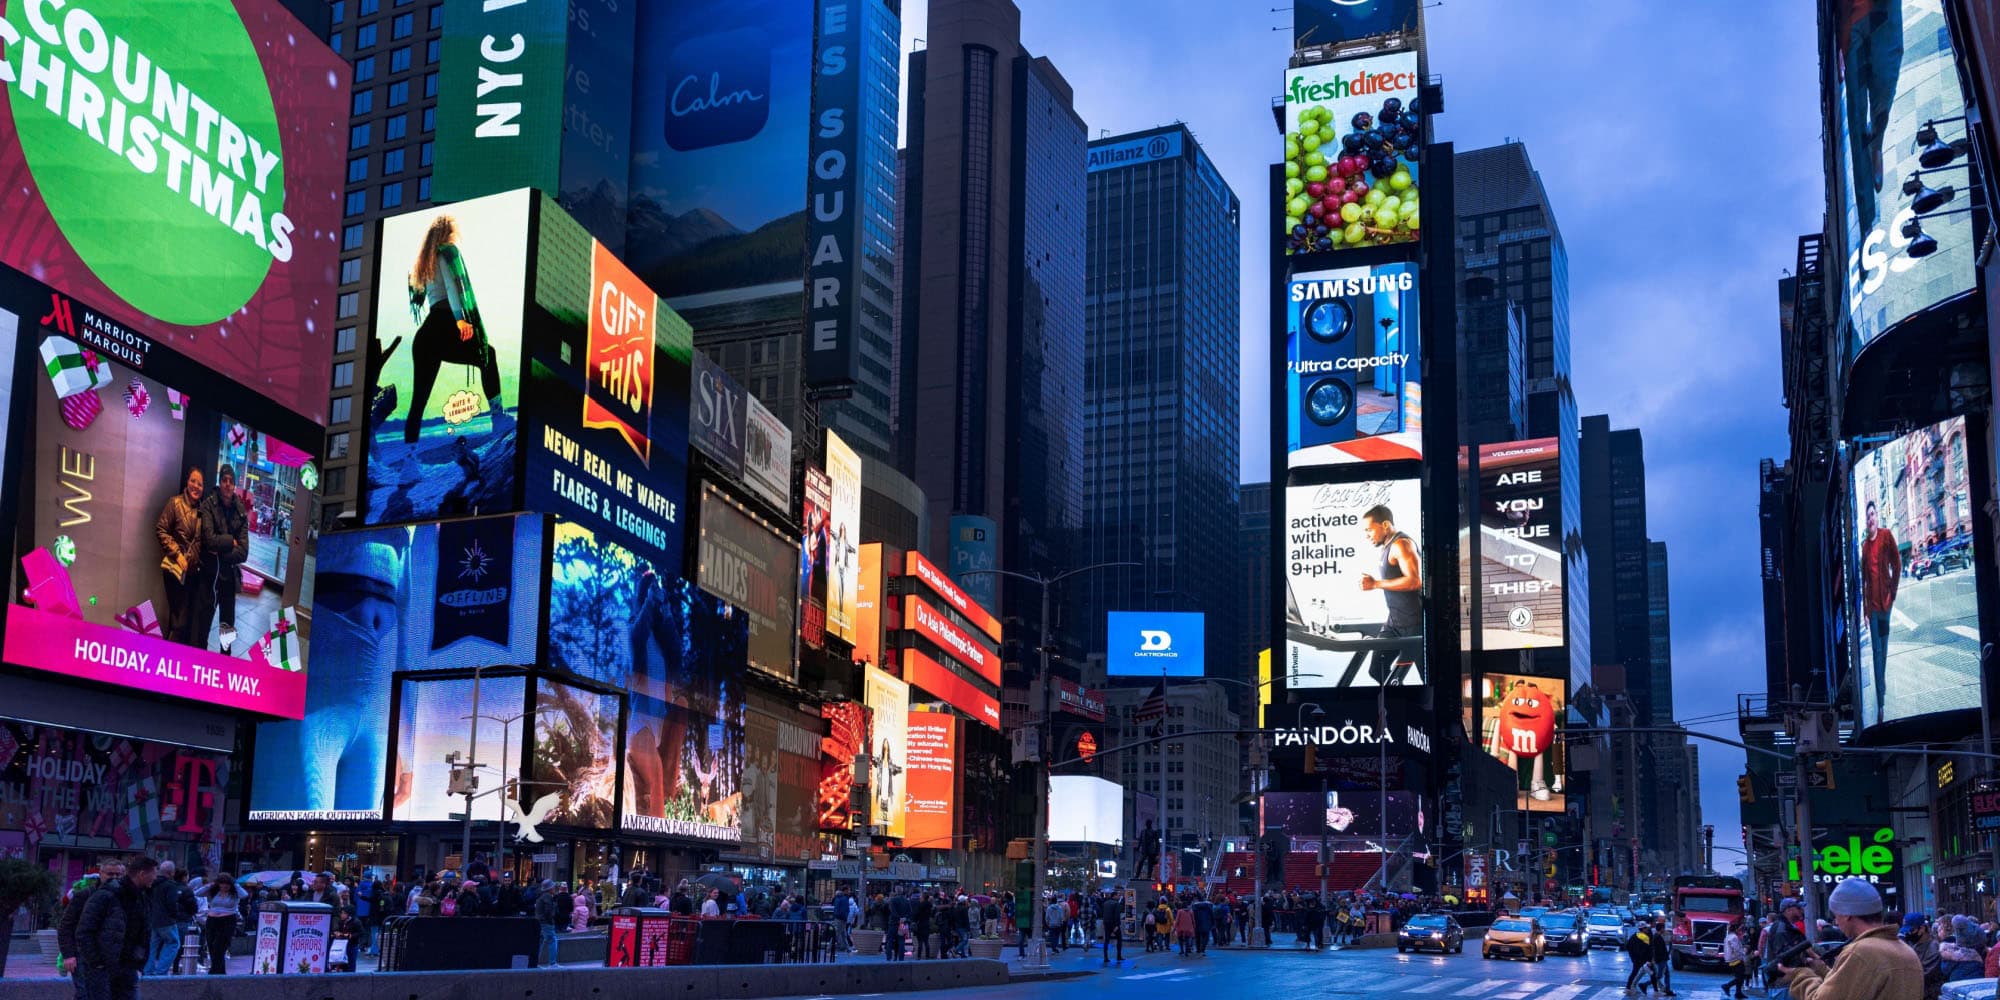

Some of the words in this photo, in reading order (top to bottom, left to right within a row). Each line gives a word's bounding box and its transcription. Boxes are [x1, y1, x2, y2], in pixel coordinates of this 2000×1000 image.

[23, 0, 281, 194] COUNTRY
[474, 32, 526, 139] NYC
[669, 71, 764, 118] Calm
[1290, 70, 1417, 105] freshdirect
[568, 102, 620, 161] tter.
[1088, 145, 1145, 168] Allianz
[812, 107, 847, 352] SQUARE
[1291, 271, 1413, 302] SAMSUNG
[600, 280, 646, 337] GIFT
[82, 326, 143, 366] MARQUIS
[84, 311, 151, 354] MARRIOTT
[1295, 359, 1333, 374] Ultra
[1335, 351, 1410, 373] Capacity
[599, 349, 644, 414] THIS
[59, 446, 95, 527] WE
[543, 424, 579, 466] NEW!
[583, 447, 613, 487] REAL
[616, 464, 633, 498] ME
[637, 477, 676, 524] WAFFLE
[1496, 470, 1542, 487] ARE
[553, 467, 598, 514] FLARES
[602, 496, 611, 520] &
[615, 502, 667, 552] LEGGINGS
[1495, 497, 1544, 513] YOU
[1291, 513, 1358, 529] activate
[1494, 524, 1550, 541] TRUE
[1291, 529, 1327, 544] with
[1291, 544, 1356, 560] alkaline
[1504, 553, 1536, 567] TO
[1291, 560, 1343, 578] 9+pH.
[1489, 580, 1553, 596] THIS?
[917, 604, 928, 623] Our
[928, 611, 939, 631] Asia
[75, 637, 151, 674] HOLIDAY.
[155, 656, 188, 683] ALL.
[192, 664, 224, 689] THE.
[227, 672, 261, 697] WAY.
[908, 726, 926, 734] grated
[1274, 723, 1394, 747] PANDORA
[1407, 725, 1431, 754] PANDORA
[27, 755, 107, 785] HOLIDAY
[250, 811, 295, 821] AMERICAN
[297, 811, 324, 820] EAGLE
[326, 811, 381, 820] OUTFITTERS
[622, 814, 672, 834] AMERICAN
[672, 820, 698, 837] EAGLE
[699, 822, 742, 842] OUTFITTERS
[1812, 874, 1881, 884] SOCR
